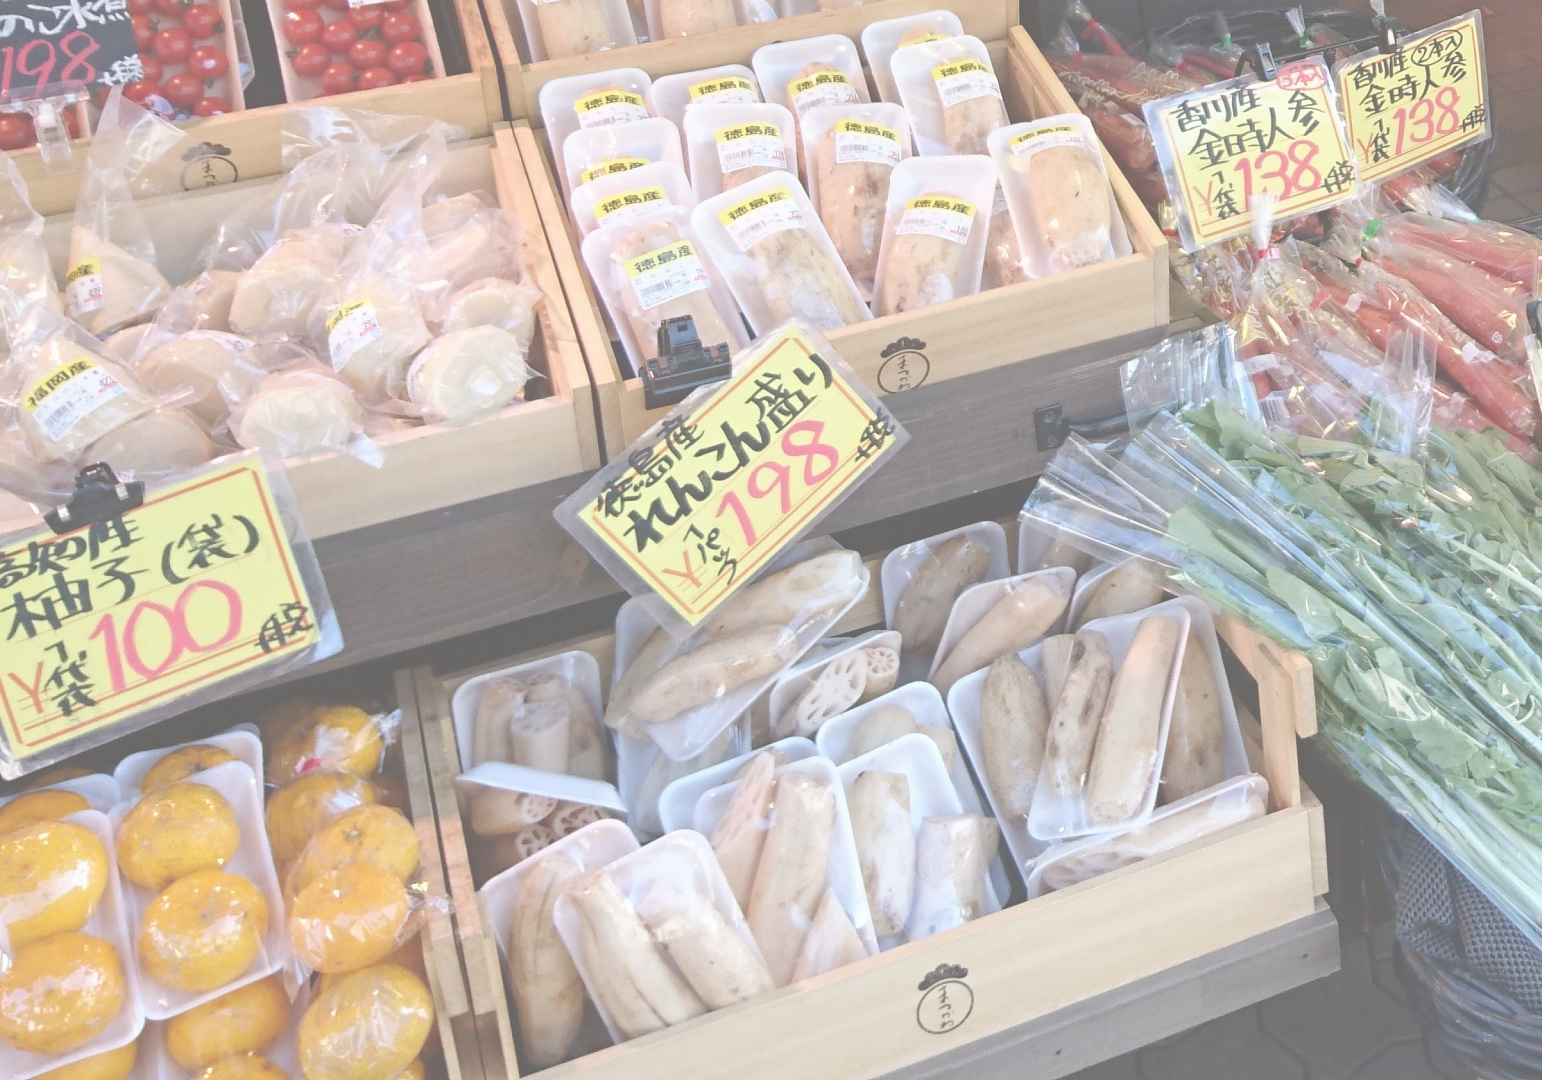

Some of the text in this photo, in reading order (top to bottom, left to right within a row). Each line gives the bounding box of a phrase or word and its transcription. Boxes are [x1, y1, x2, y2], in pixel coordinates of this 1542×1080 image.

[1, 29, 102, 104] 198
[698, 80, 754, 95] 徳島産
[795, 72, 848, 93] 徳島産
[1359, 50, 1468, 119] 金時人参
[584, 94, 641, 112] 徳島産
[724, 125, 779, 141] 徳島産
[844, 120, 897, 142] 徳島産
[1187, 89, 1326, 168] 金時人参
[1391, 85, 1461, 157] 138
[1232, 138, 1324, 214] 138
[601, 190, 662, 214] 徳島産
[728, 190, 788, 221] 徳島産
[913, 198, 972, 216] 徳島産
[633, 244, 694, 274] 徳島産
[623, 352, 833, 553] れんこん盛り
[714, 418, 840, 548] 198
[88, 578, 244, 694] 100
